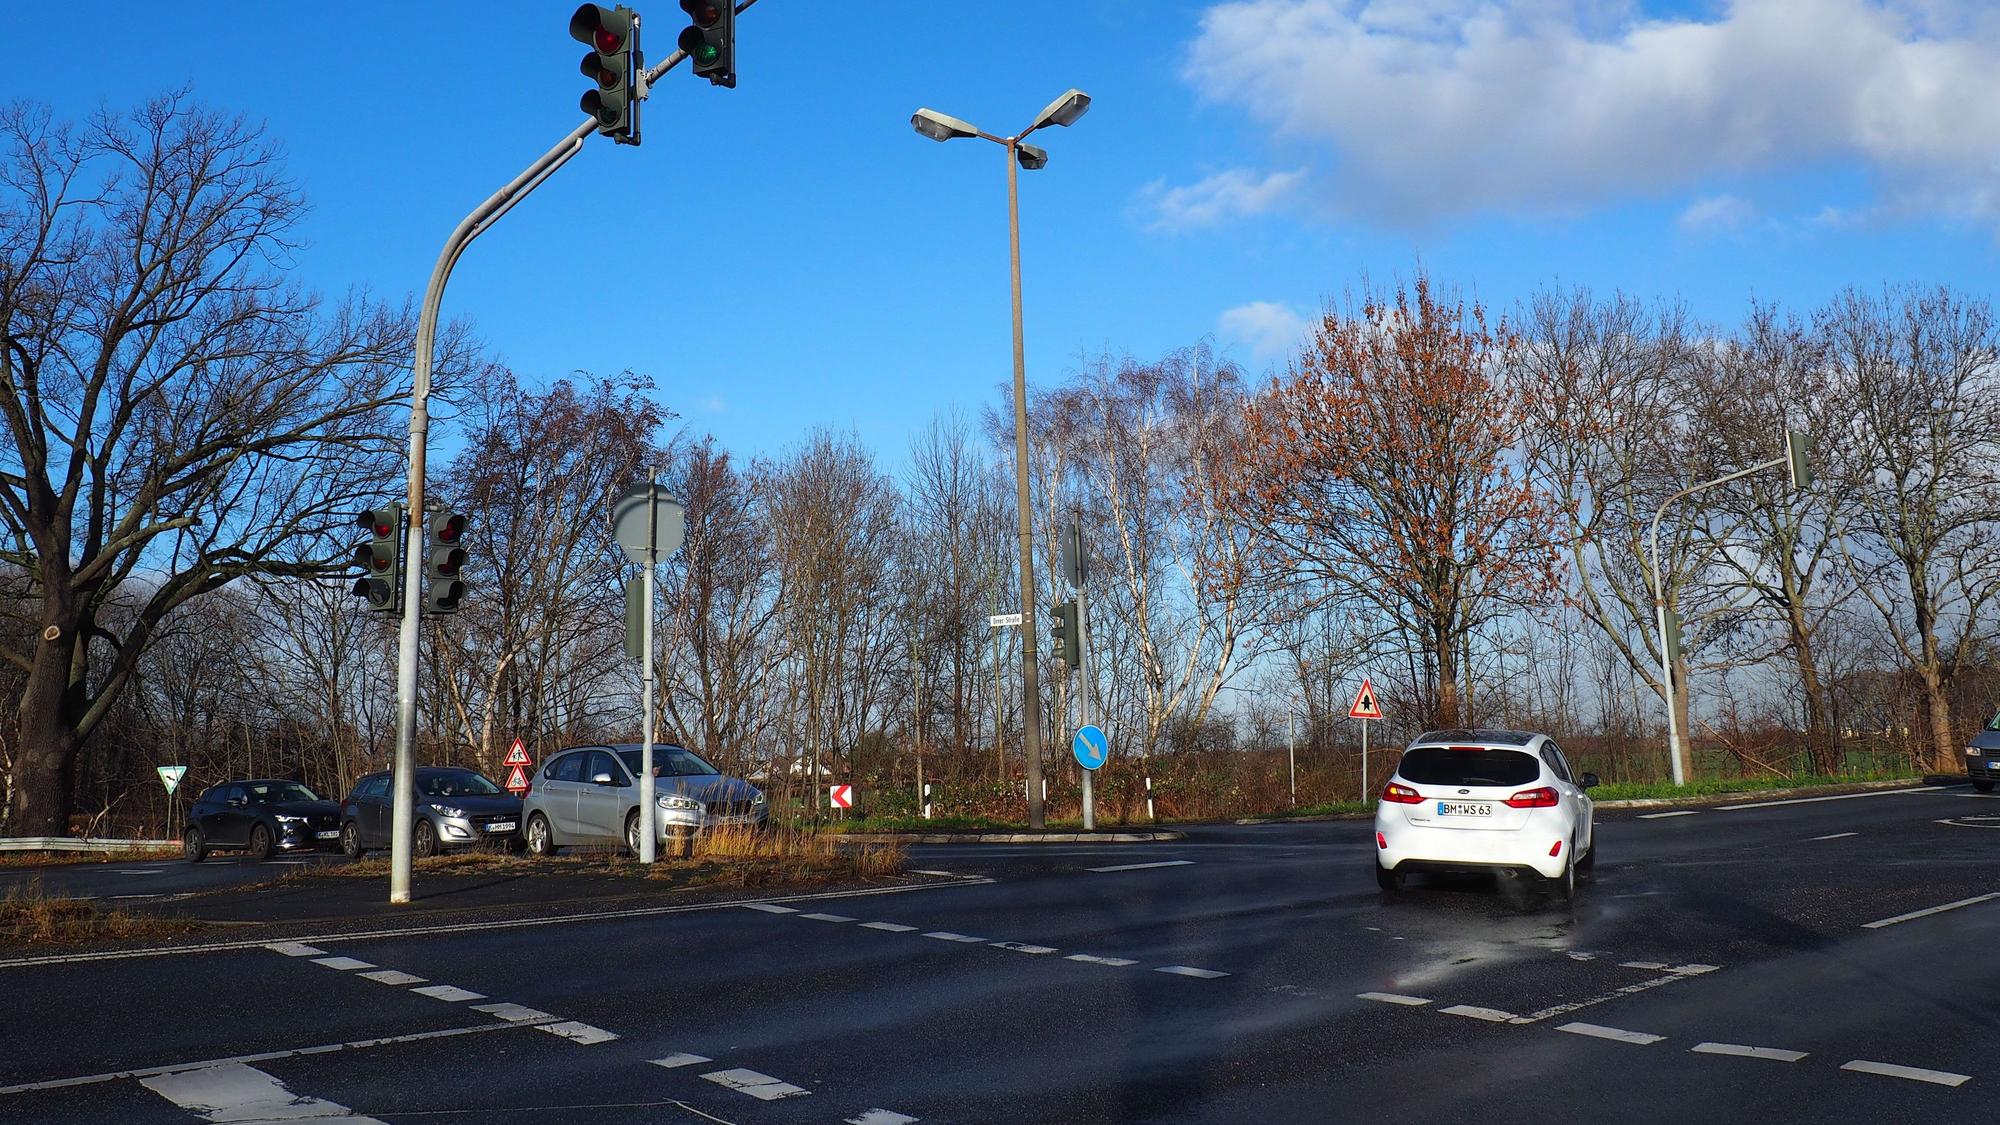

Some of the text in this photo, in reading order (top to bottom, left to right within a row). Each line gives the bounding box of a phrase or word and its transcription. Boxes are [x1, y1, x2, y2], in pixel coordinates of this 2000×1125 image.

[1443, 804, 1491, 816] BM WS 63
